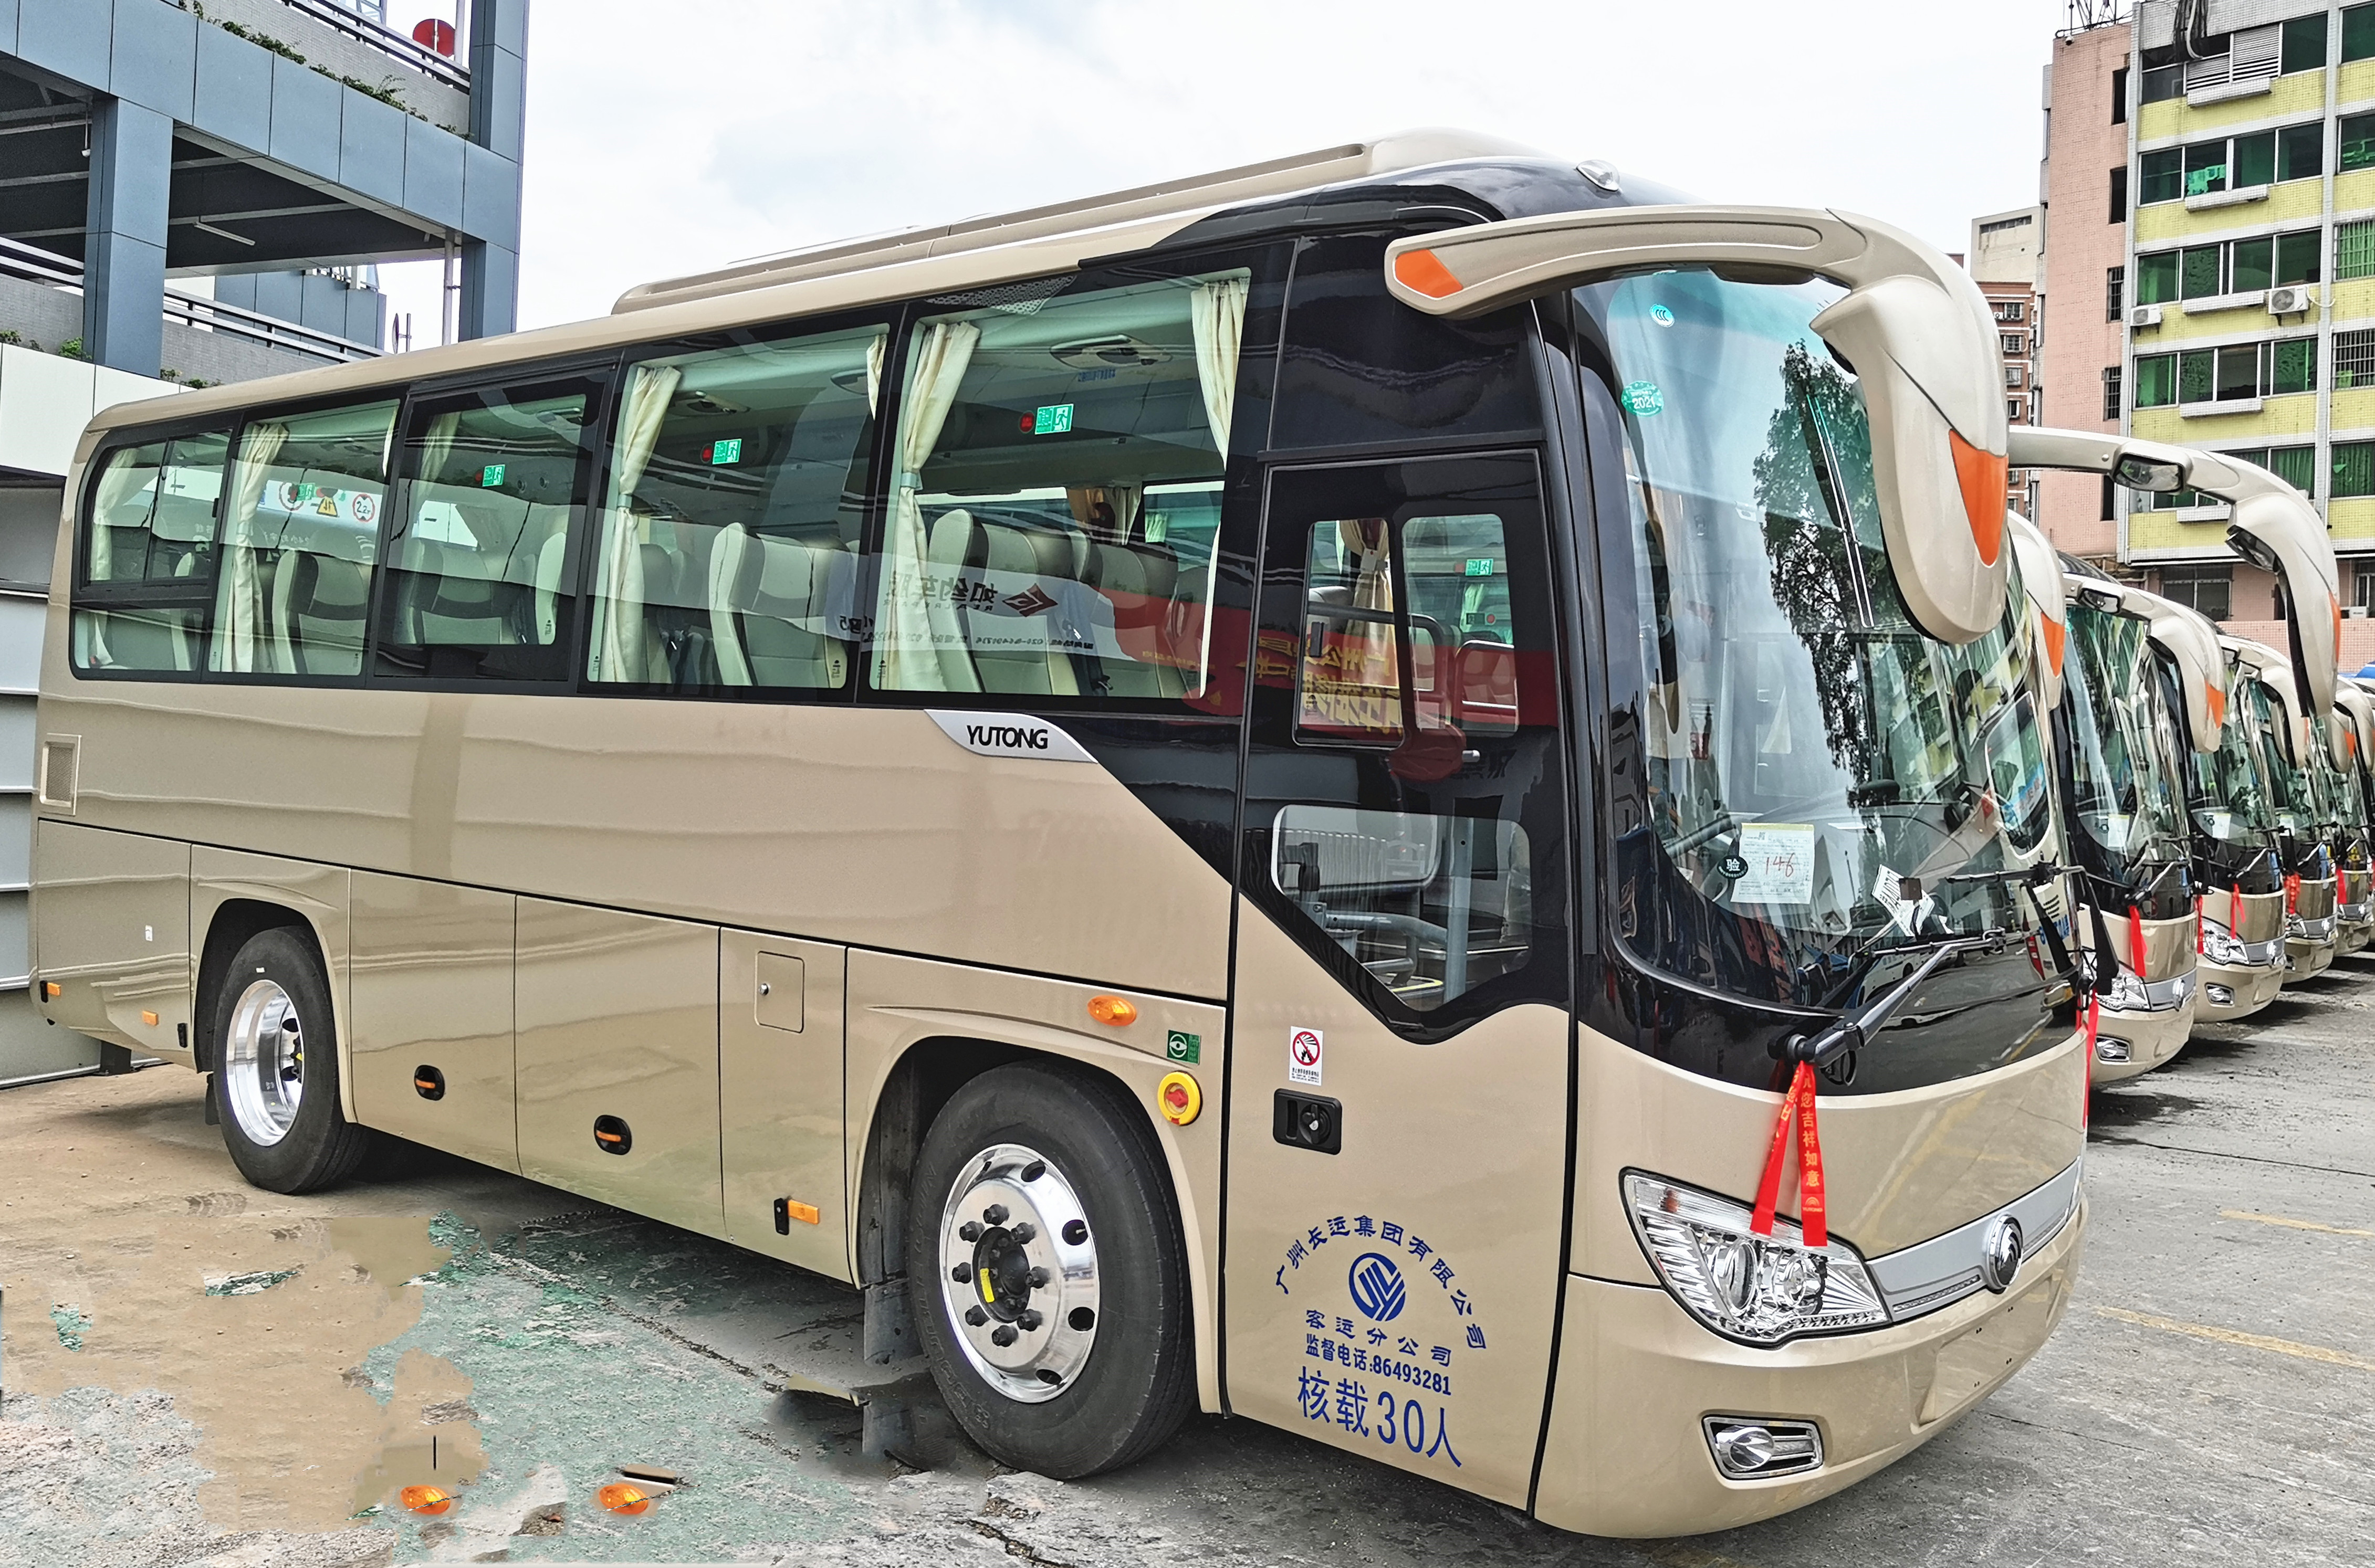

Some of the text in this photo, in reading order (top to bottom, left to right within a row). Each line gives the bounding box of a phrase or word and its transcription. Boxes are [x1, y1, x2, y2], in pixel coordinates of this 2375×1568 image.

[1632, 397, 1656, 409] 2021
[966, 724, 1049, 750] YUTONG
[1725, 858, 1741, 872] 验
[1765, 853, 1795, 877] 146
[1275, 1215, 1487, 1350] 广州长运集团有限公司
[1305, 1309, 1452, 1367] 客运分公司
[1298, 1366, 1462, 1468] 核载30人
